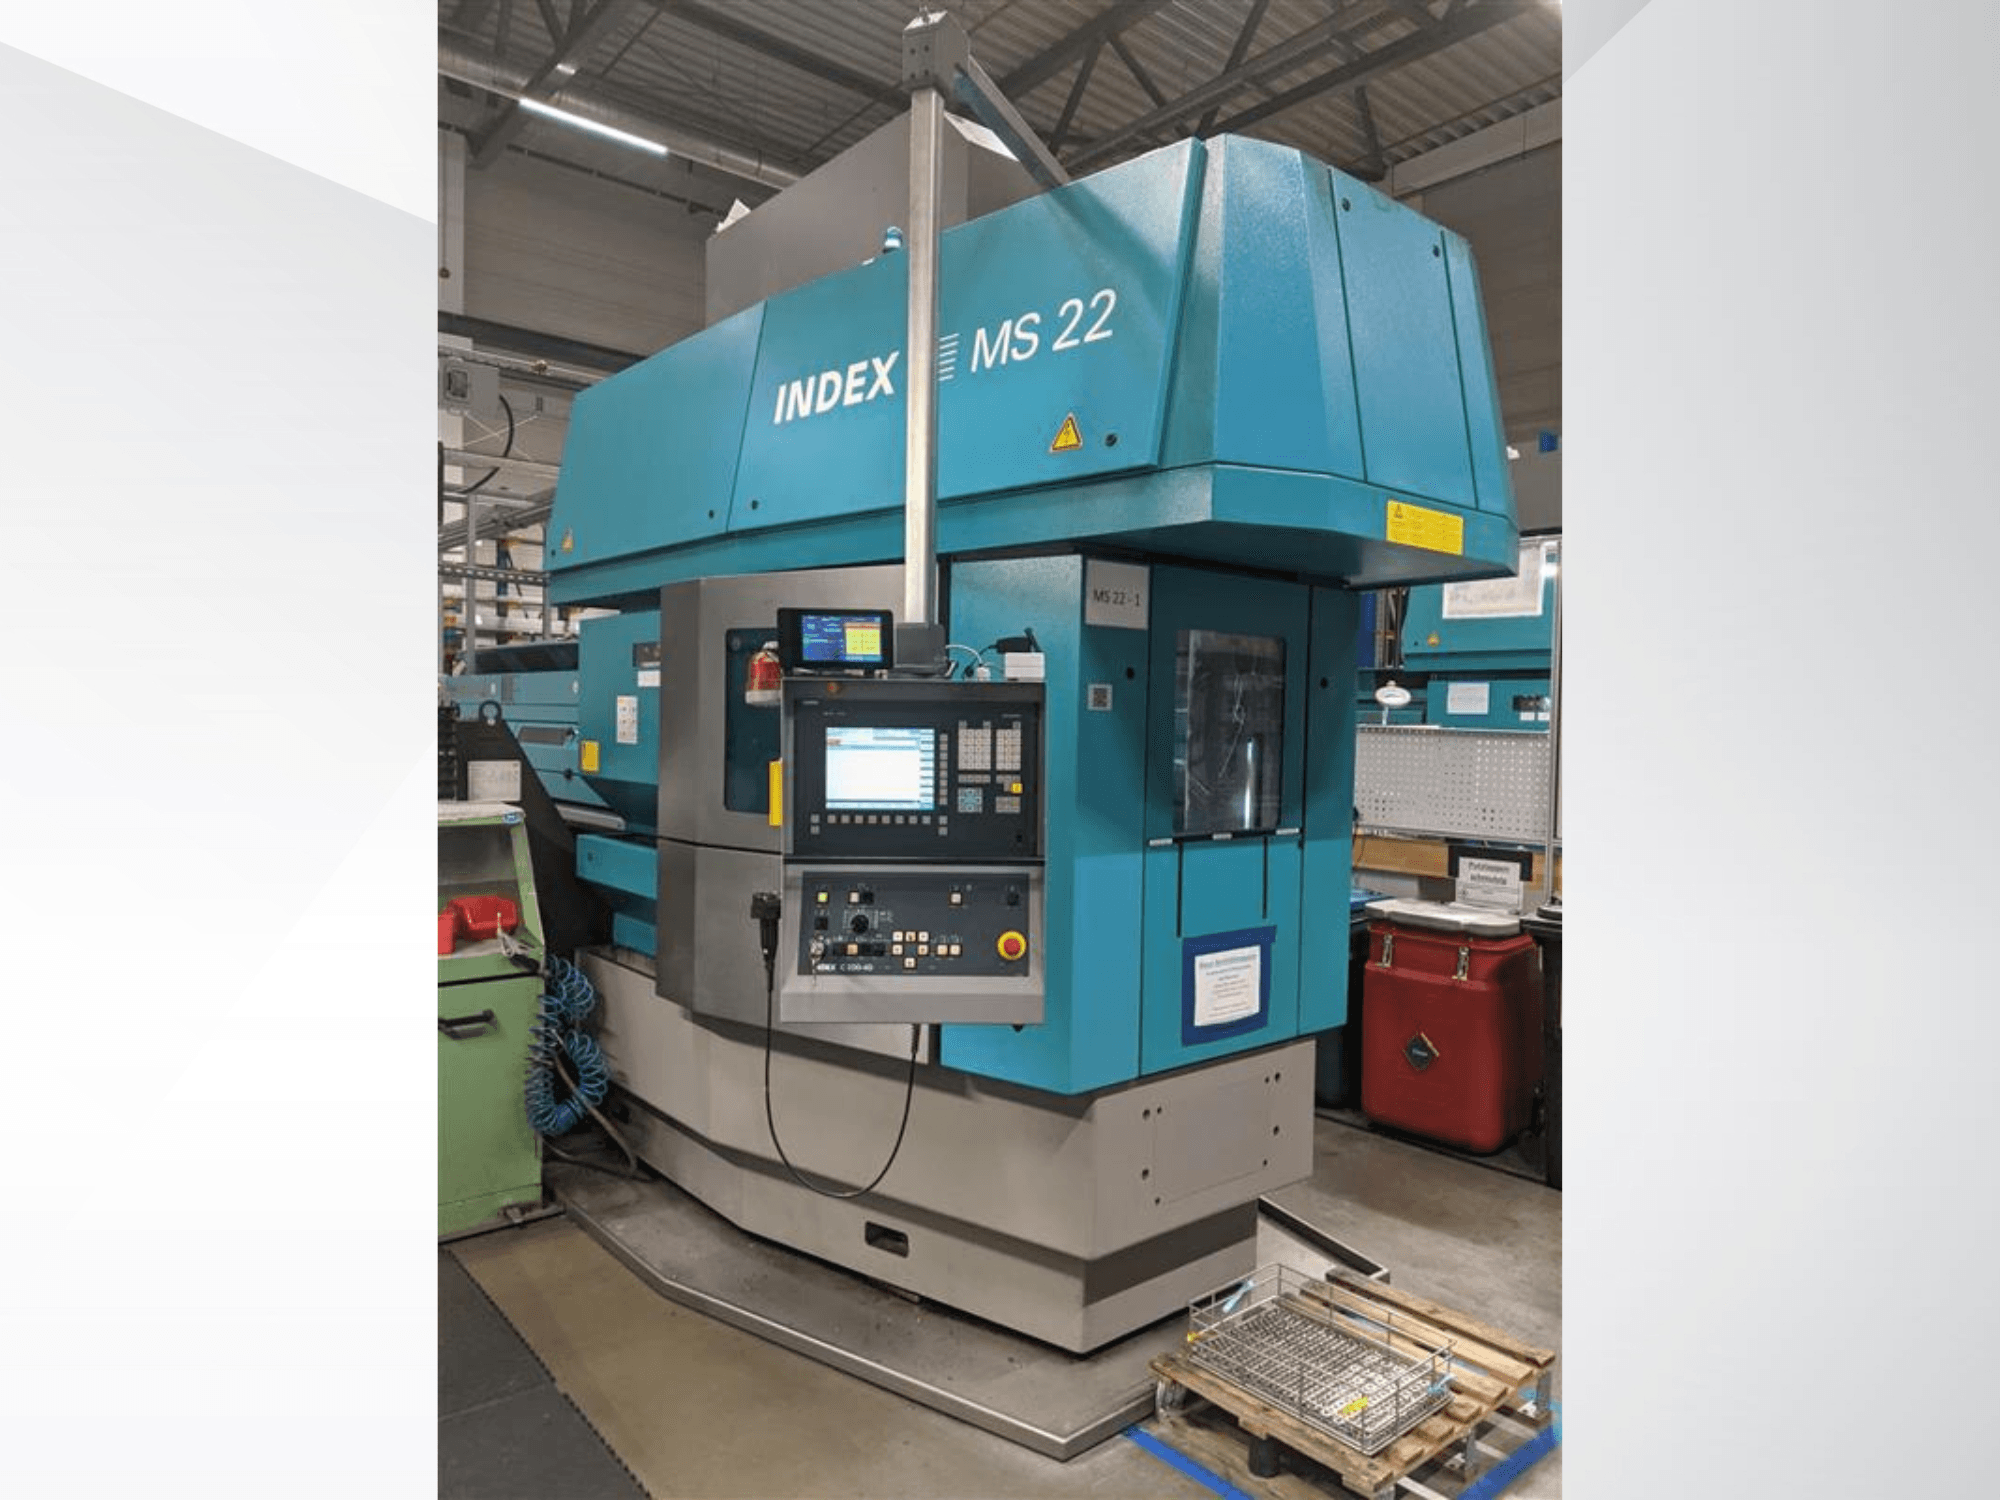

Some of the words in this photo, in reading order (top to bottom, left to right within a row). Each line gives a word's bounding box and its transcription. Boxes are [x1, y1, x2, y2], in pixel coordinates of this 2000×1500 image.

[970, 312, 1041, 373] MS
[1052, 288, 1117, 351] 22
[773, 351, 899, 425] INDEX
[1093, 588, 1111, 604] MS
[1112, 591, 1127, 605] 22
